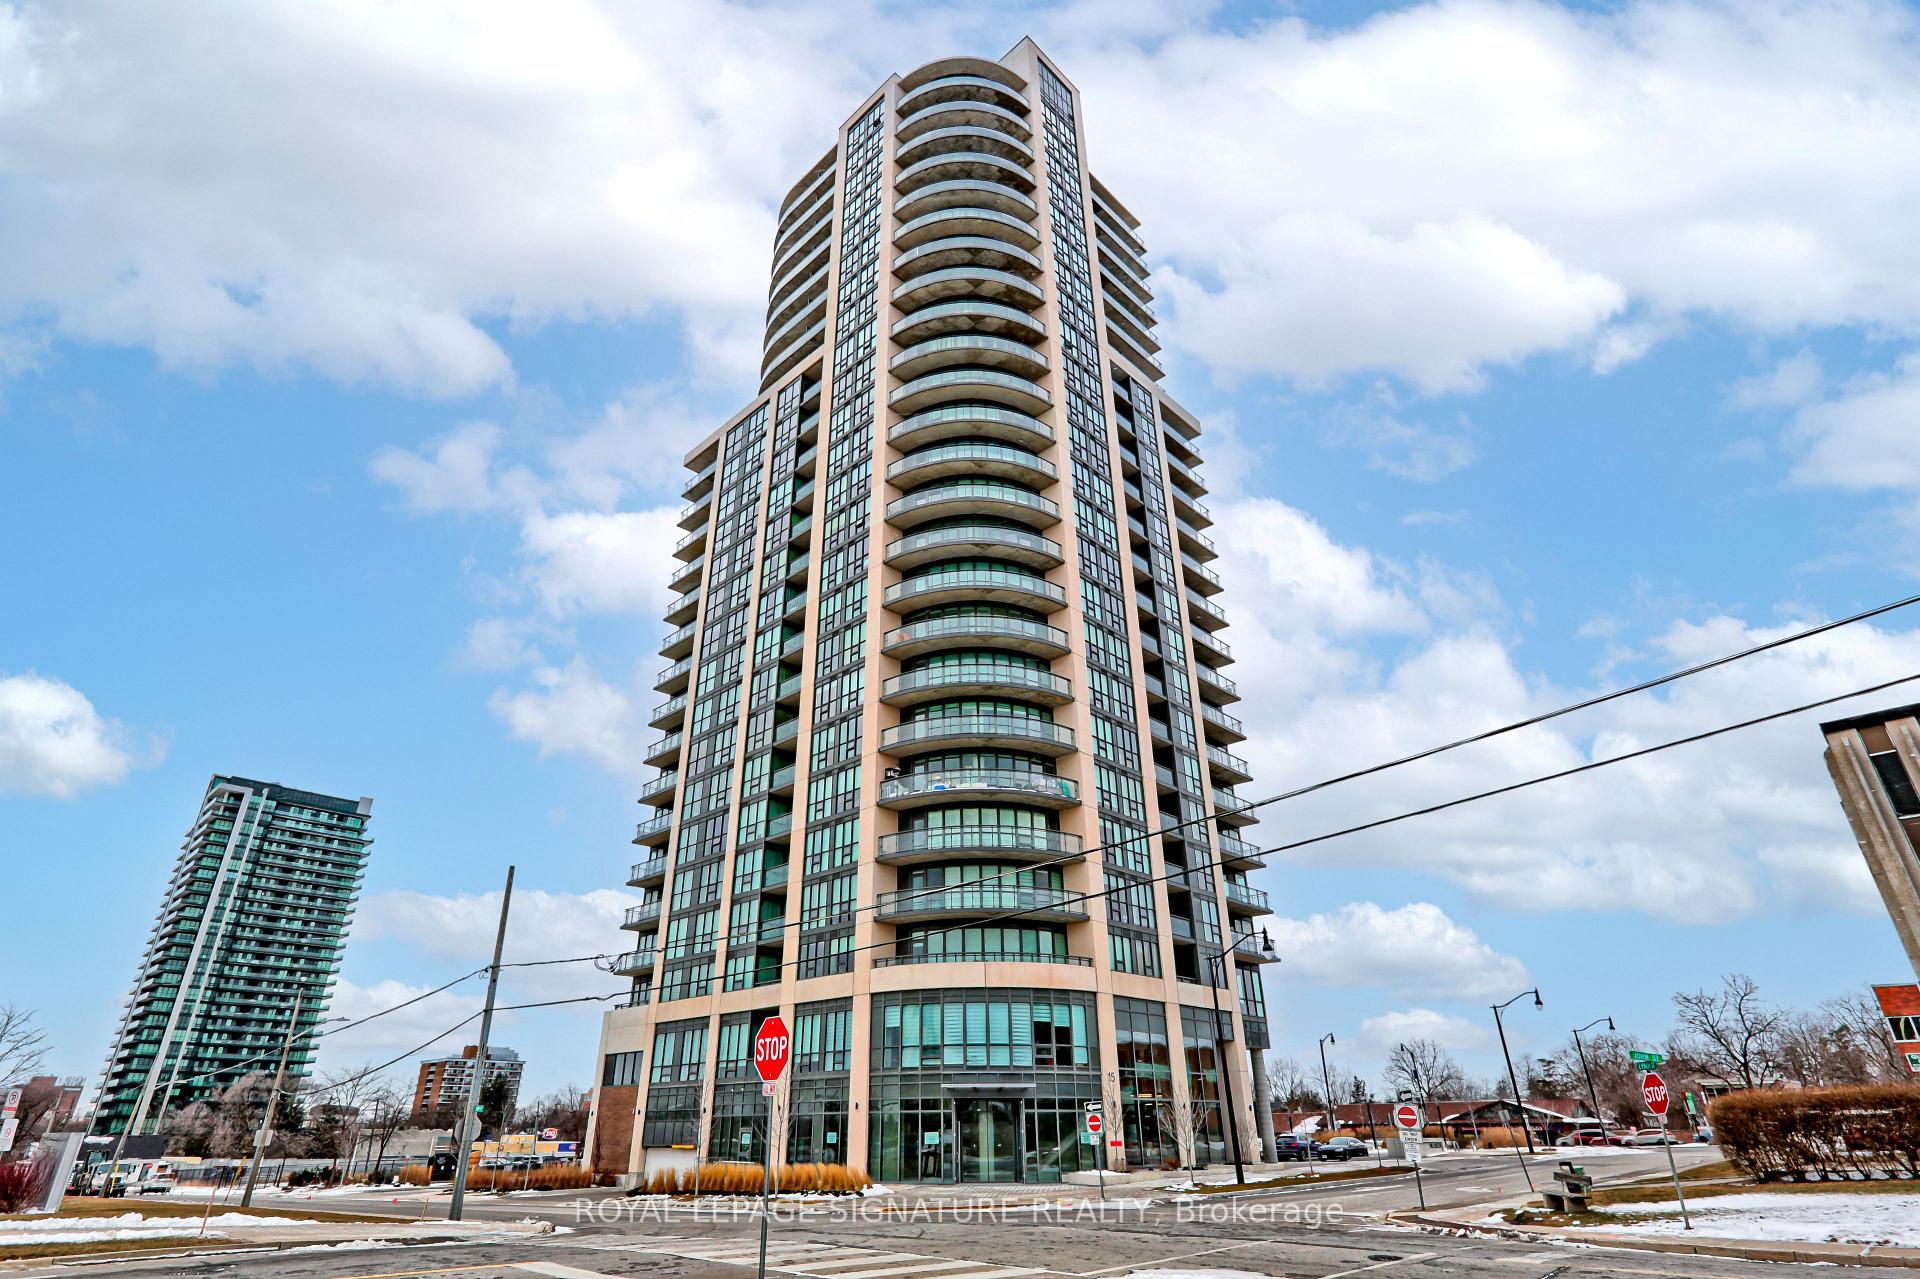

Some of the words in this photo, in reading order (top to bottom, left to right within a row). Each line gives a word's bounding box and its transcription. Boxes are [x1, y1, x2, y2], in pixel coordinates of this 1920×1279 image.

[757, 1036, 788, 1062] STOP
[1634, 1052, 1649, 1060] JOHN
[1108, 1072, 1116, 1083] 15
[1645, 1085, 1666, 1103] STOP
